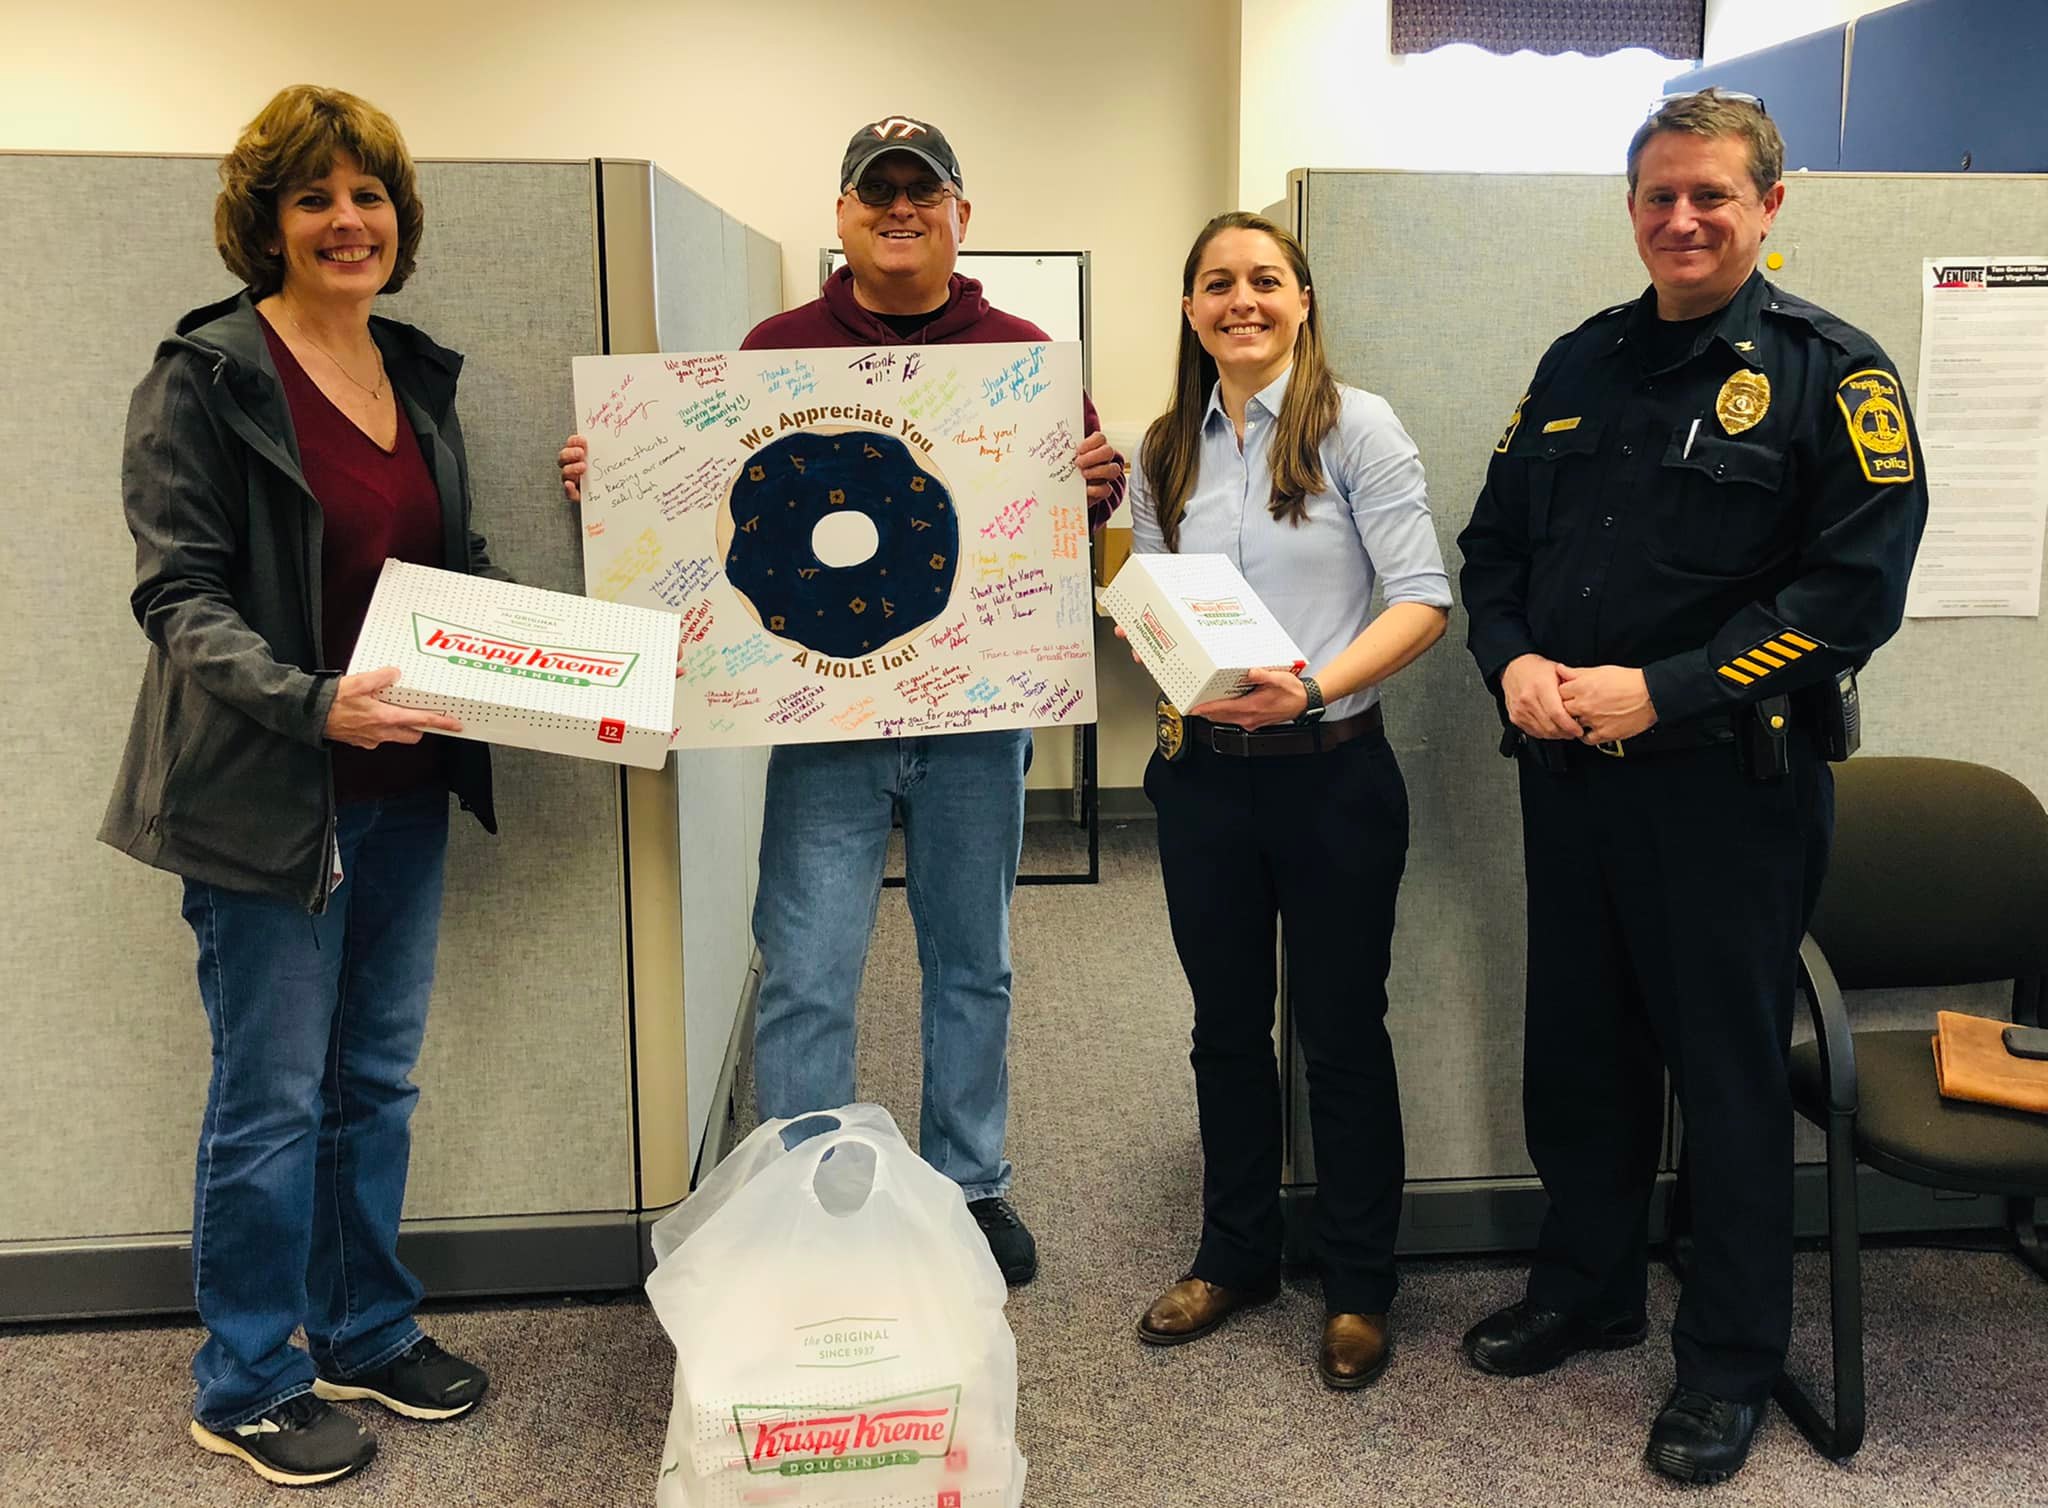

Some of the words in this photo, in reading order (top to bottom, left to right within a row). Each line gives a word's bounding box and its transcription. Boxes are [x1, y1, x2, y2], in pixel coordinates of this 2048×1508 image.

[873, 118, 927, 140] VT
[1932, 266, 1985, 284] VENTURE
[739, 424, 774, 450] We
[778, 403, 894, 431] Appreciate
[900, 418, 935, 453] You
[1873, 457, 1907, 471] Police
[425, 629, 529, 668] Krispy
[526, 648, 625, 679] Kreme
[792, 650, 808, 668] A
[815, 658, 876, 679] HOLE
[882, 644, 920, 671] lot!
[458, 657, 582, 687] DOUGHNUTS
[604, 725, 618, 738] 12
[803, 1334, 821, 1347] the
[823, 1329, 890, 1345] ORIGINAL
[819, 1348, 851, 1359] SINCE
[853, 1346, 875, 1357] 1937
[753, 1415, 855, 1460] Krispy
[853, 1408, 948, 1449] Kreme
[790, 1453, 911, 1473] DOUGHNUTS
